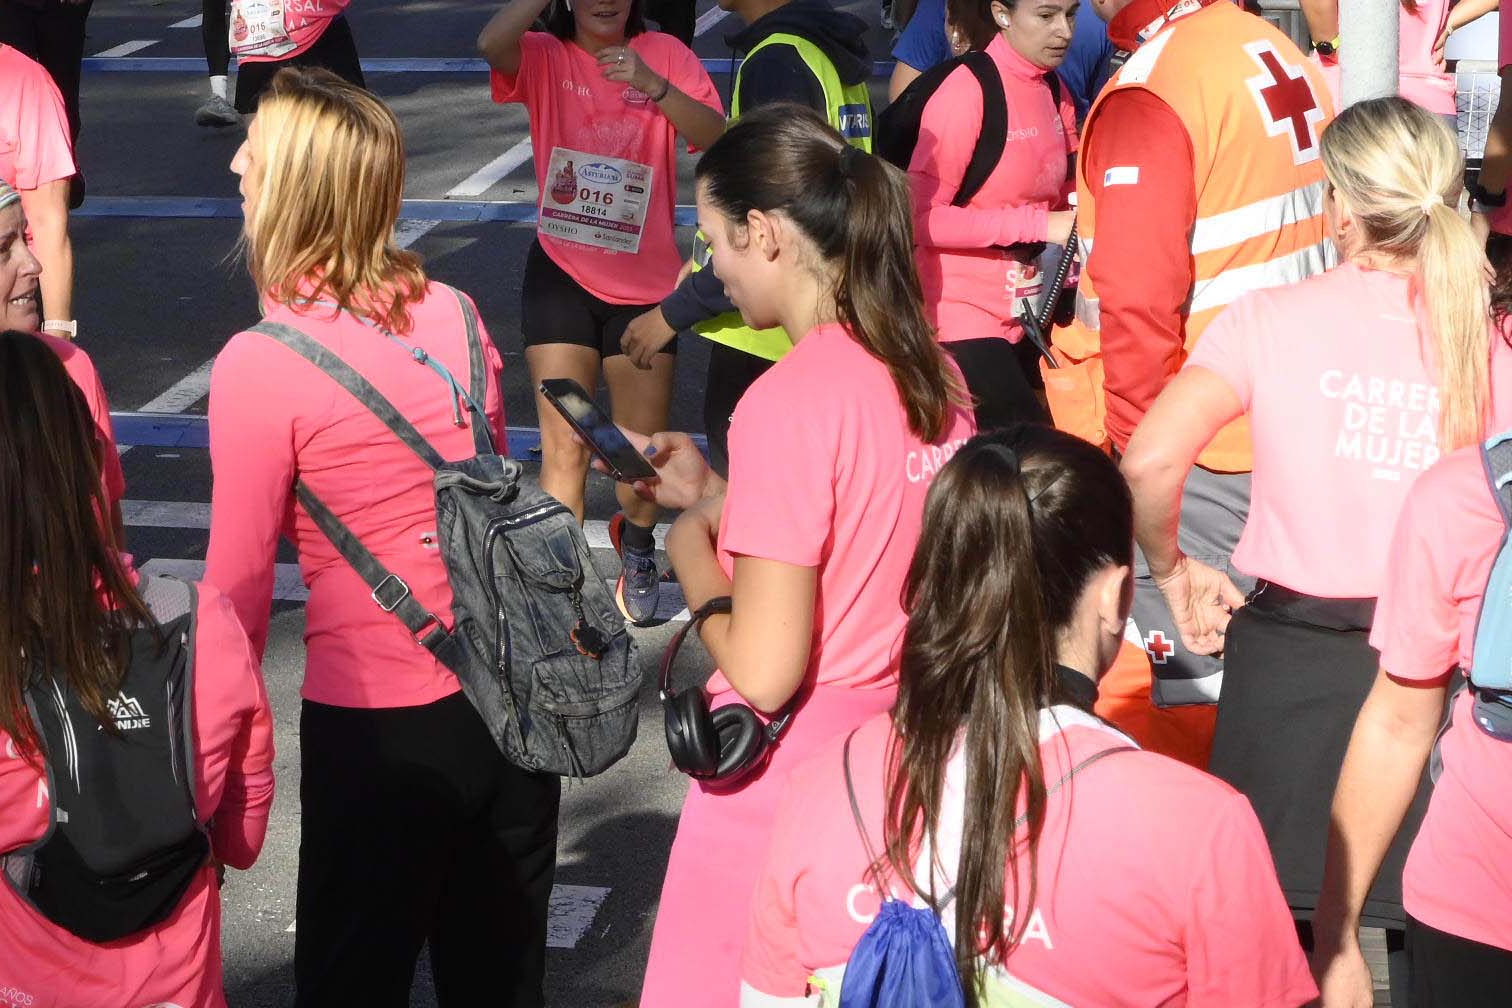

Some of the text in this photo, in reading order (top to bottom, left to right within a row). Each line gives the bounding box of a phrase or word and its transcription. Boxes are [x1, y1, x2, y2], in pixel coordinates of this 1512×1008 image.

[579, 187, 614, 206] 016
[552, 211, 580, 223] CARRERA
[581, 204, 607, 217] 18814
[1344, 401, 1437, 447] DE LA
